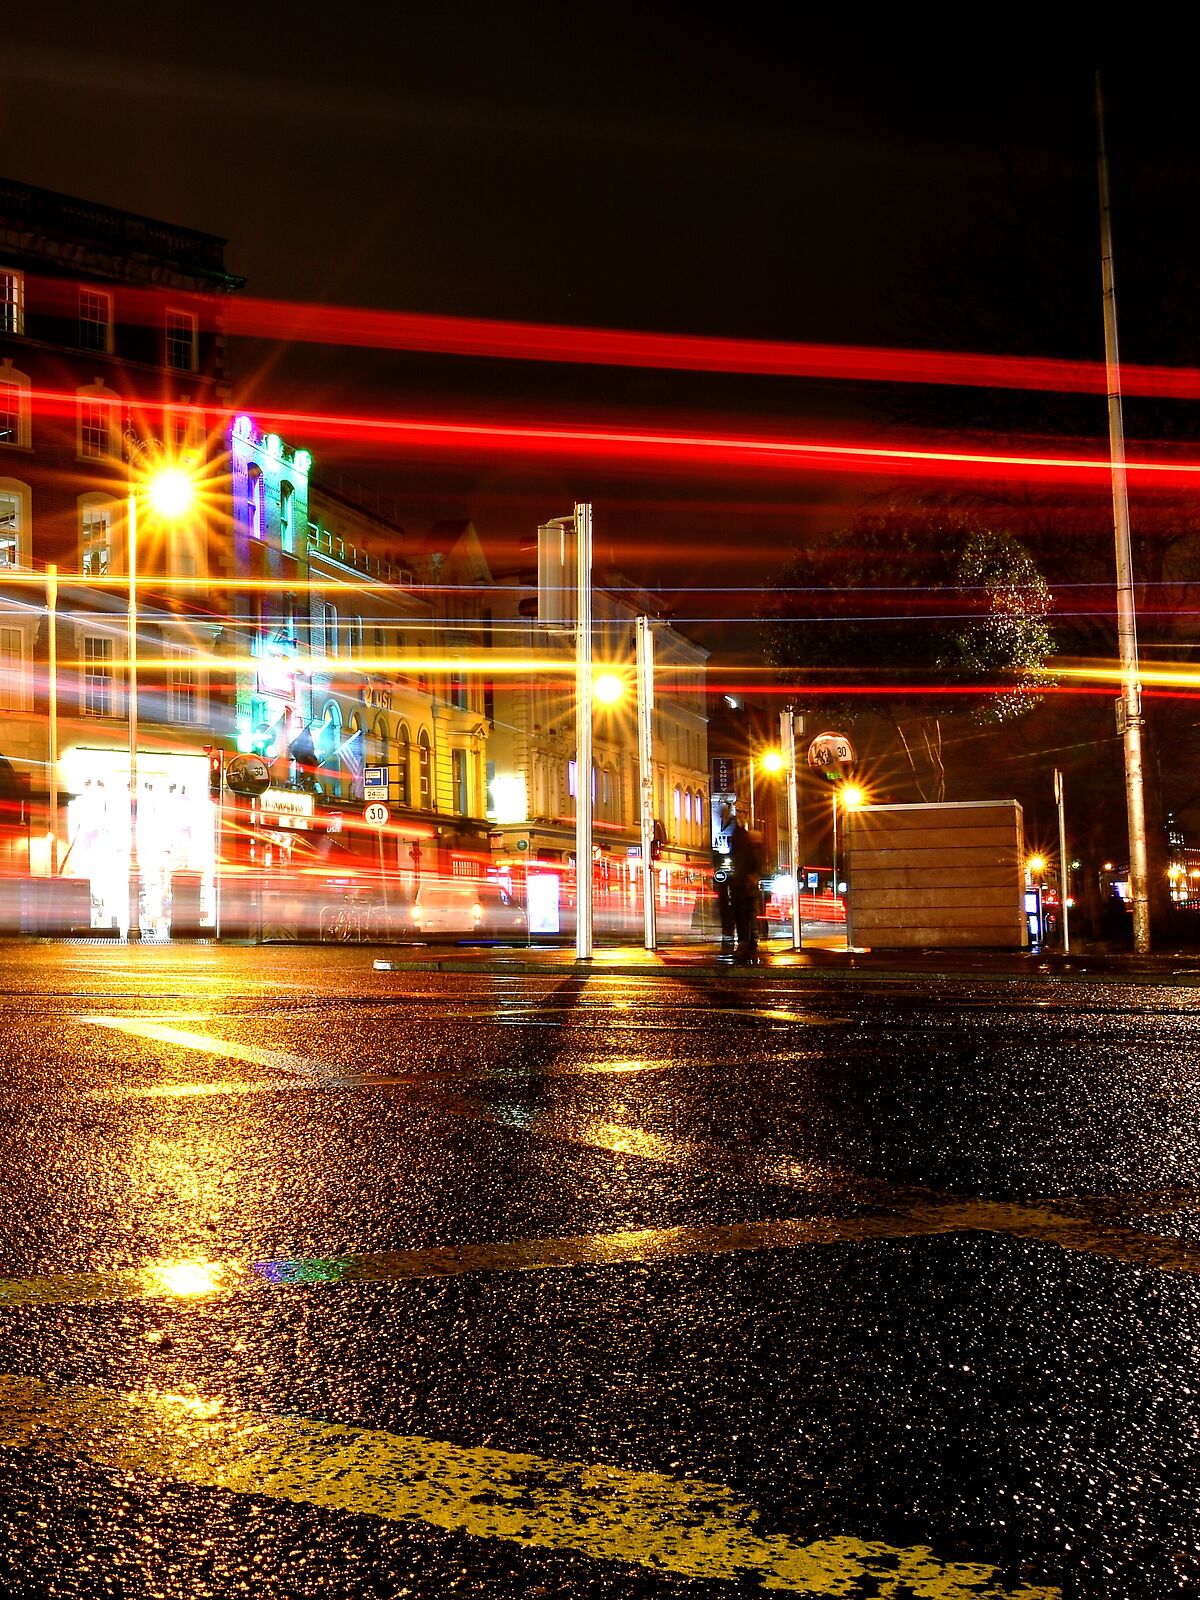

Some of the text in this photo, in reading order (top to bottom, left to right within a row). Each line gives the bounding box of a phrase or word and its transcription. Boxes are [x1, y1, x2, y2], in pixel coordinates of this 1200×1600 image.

[837, 746, 847, 758] 30
[719, 760, 727, 792] LAUNDRY
[370, 808, 384, 820] 30
